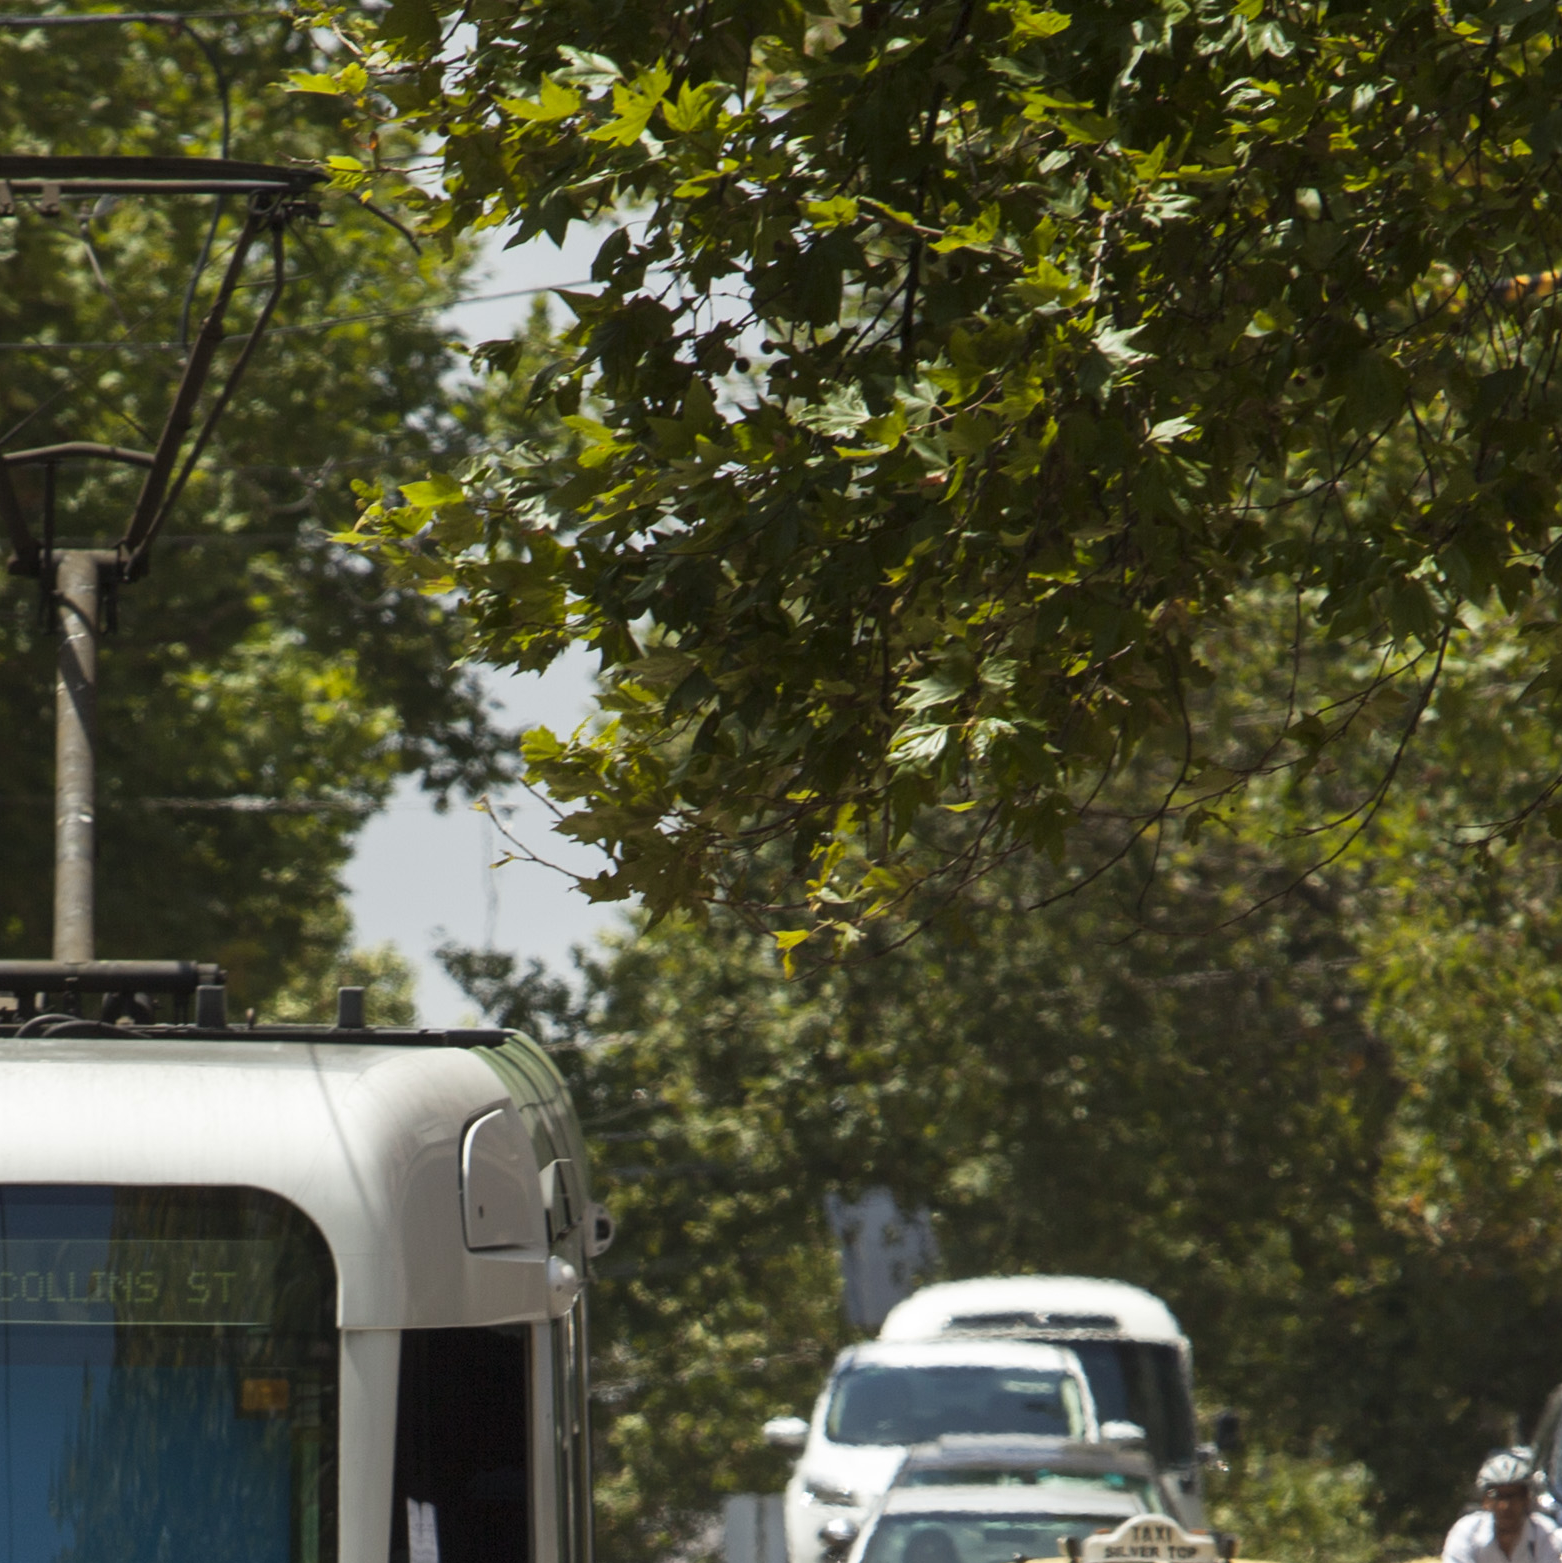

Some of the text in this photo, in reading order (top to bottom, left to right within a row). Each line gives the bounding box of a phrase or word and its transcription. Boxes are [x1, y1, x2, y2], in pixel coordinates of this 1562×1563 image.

[187, 1271, 236, 1303] ST
[1131, 1526, 1173, 1542] TAXI
[1104, 1546, 1197, 1559] SILVER TOP
